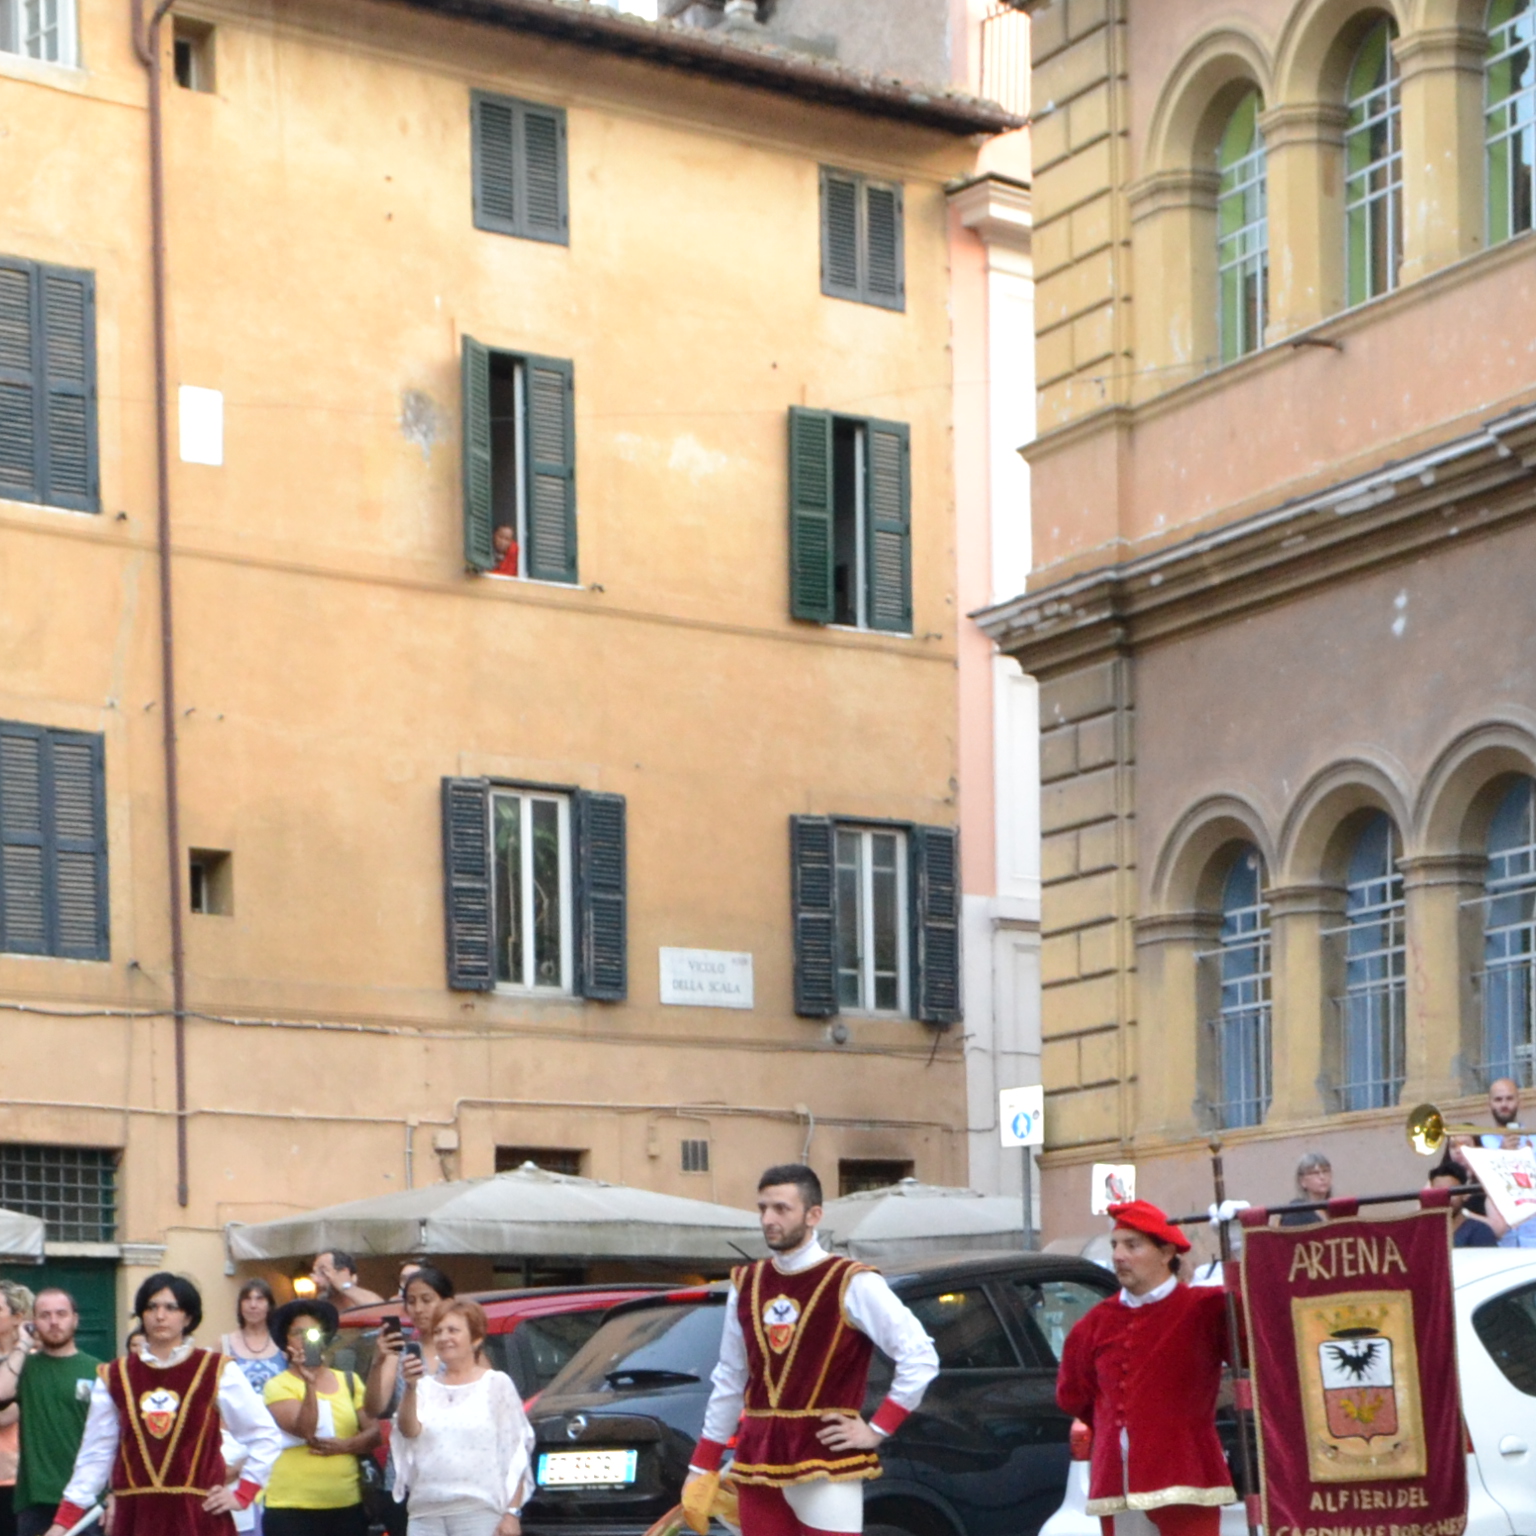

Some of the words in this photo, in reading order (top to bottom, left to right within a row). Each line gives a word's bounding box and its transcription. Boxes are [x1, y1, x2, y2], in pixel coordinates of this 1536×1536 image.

[688, 960, 727, 975] VICOLO
[672, 978, 704, 993] DELLA
[708, 979, 741, 994] SCALA
[1287, 1236, 1408, 1283] ARTENA
[1309, 1488, 1393, 1513] ALFIERI
[1394, 1486, 1430, 1509] DEL
